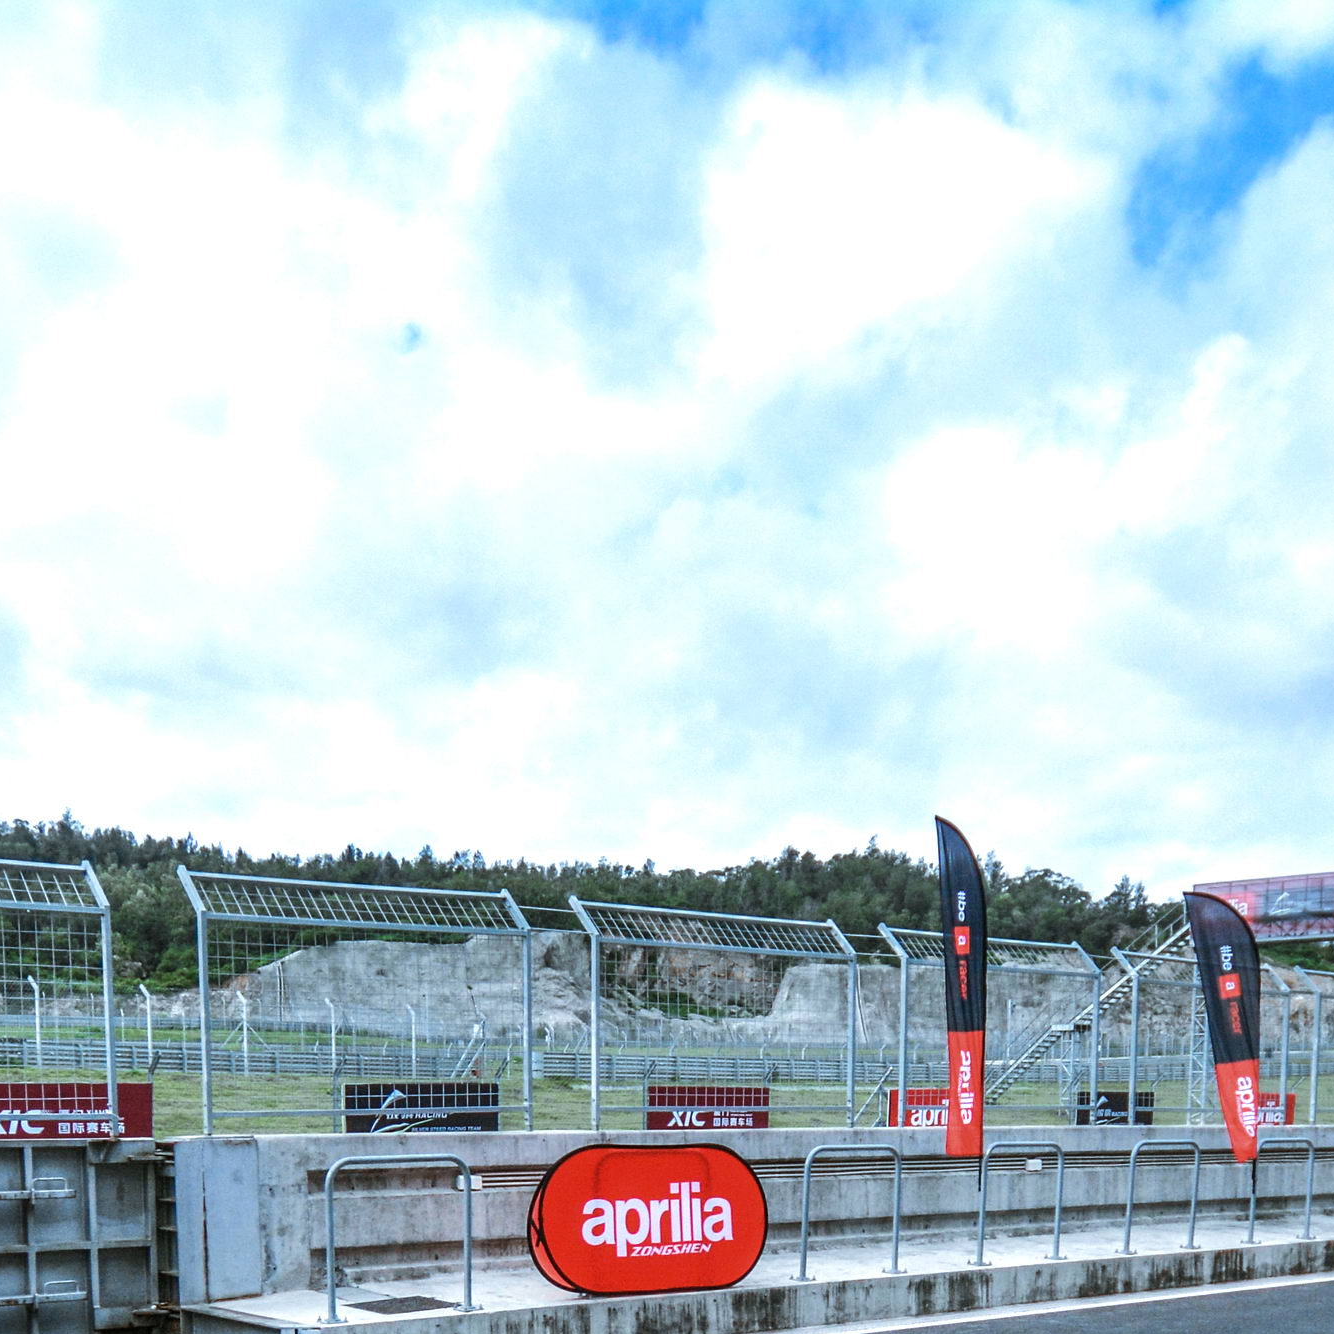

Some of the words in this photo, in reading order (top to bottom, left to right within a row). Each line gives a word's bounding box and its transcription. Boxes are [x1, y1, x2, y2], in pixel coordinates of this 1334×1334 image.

[1225, 981, 1236, 991] a
[959, 1050, 975, 1125] aprilia
[667, 1111, 706, 1127] XIC
[581, 1181, 734, 1258] aprilia
[629, 1242, 712, 1258] ZONGSHEN
